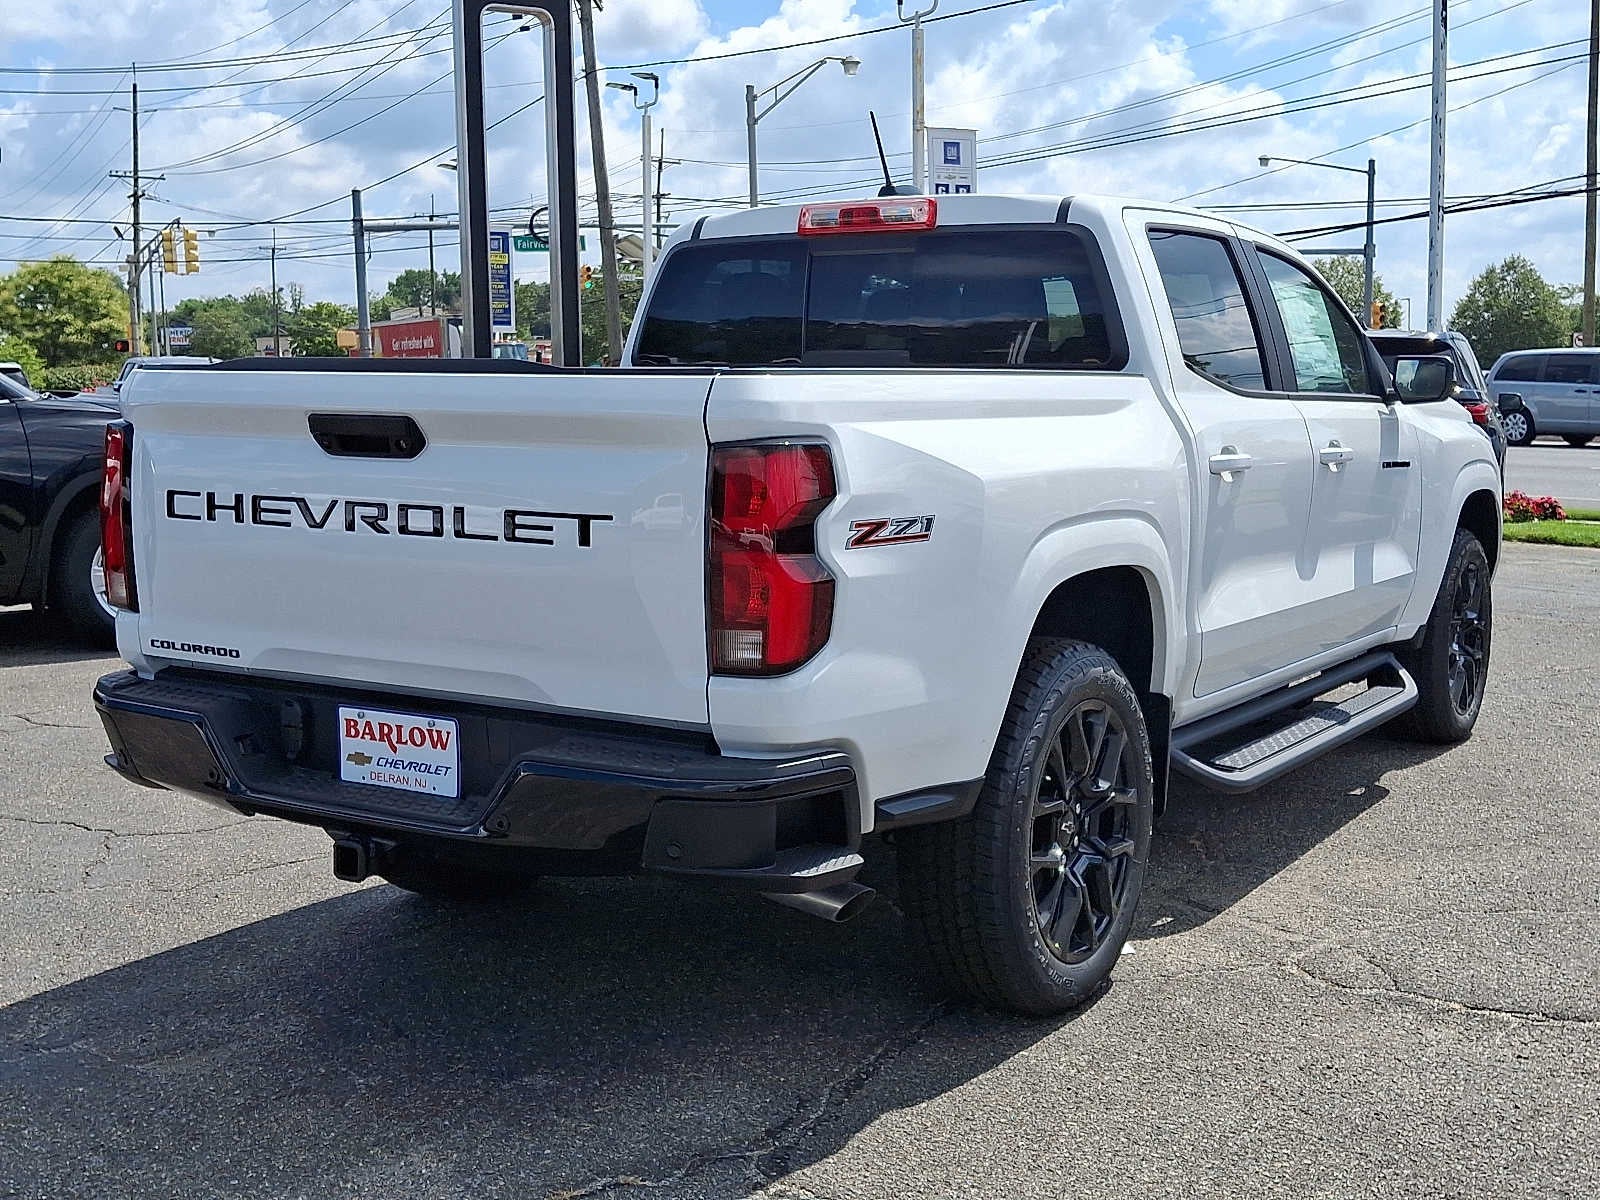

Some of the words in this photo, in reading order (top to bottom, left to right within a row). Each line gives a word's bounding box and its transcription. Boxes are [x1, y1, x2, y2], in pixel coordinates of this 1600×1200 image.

[517, 239, 549, 249] Fairvie
[166, 489, 614, 548] CHEVROLET
[845, 514, 935, 550] Z71
[150, 639, 240, 658] COLORADO
[344, 718, 451, 754] BARLOW
[376, 756, 452, 777] CHEVROLET
[369, 771, 412, 788] DELRAN,
[414, 779, 427, 789] NJ
